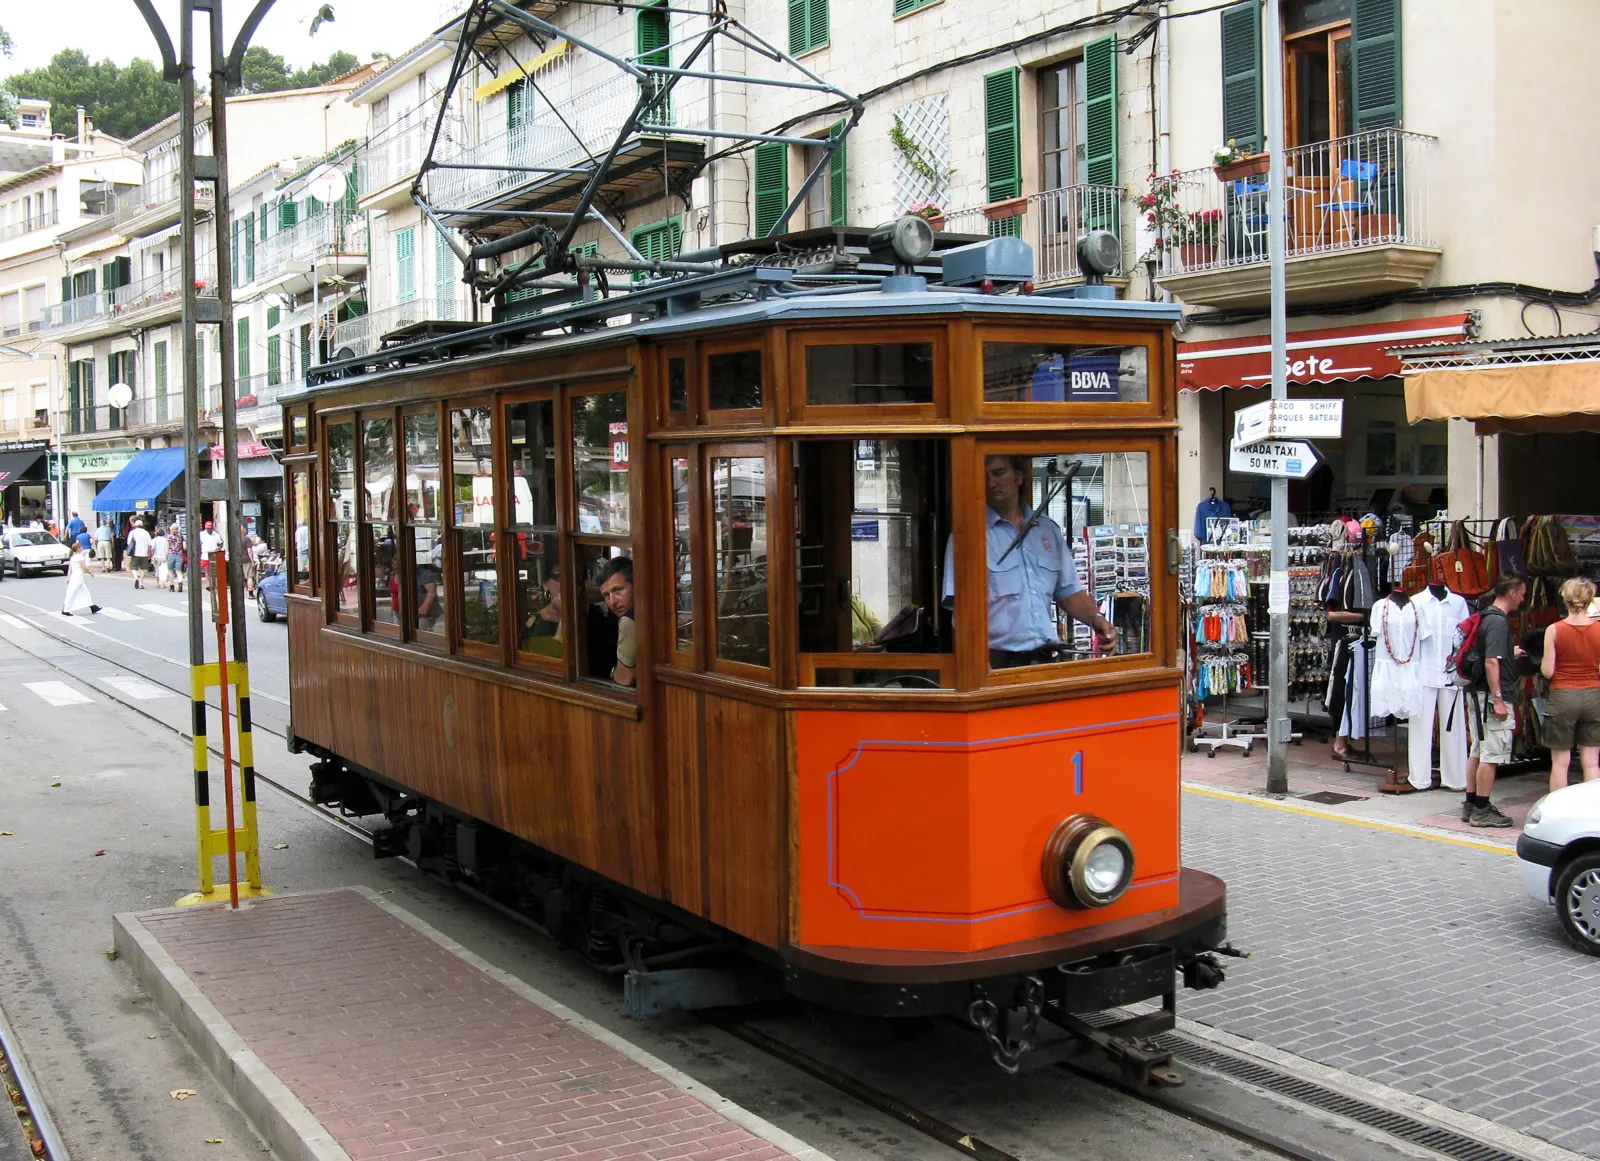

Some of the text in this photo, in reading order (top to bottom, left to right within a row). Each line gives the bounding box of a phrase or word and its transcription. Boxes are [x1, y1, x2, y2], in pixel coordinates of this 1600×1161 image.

[1071, 371, 1111, 389] BBVA
[1268, 402, 1338, 411] BARCO SCHIFF
[1267, 414, 1340, 423] BARQUES BATEAU
[1234, 445, 1298, 457] ARADA TAXI
[1249, 458, 1261, 468] 50
[1263, 459, 1280, 470] MT.
[1071, 750, 1084, 795] 1
